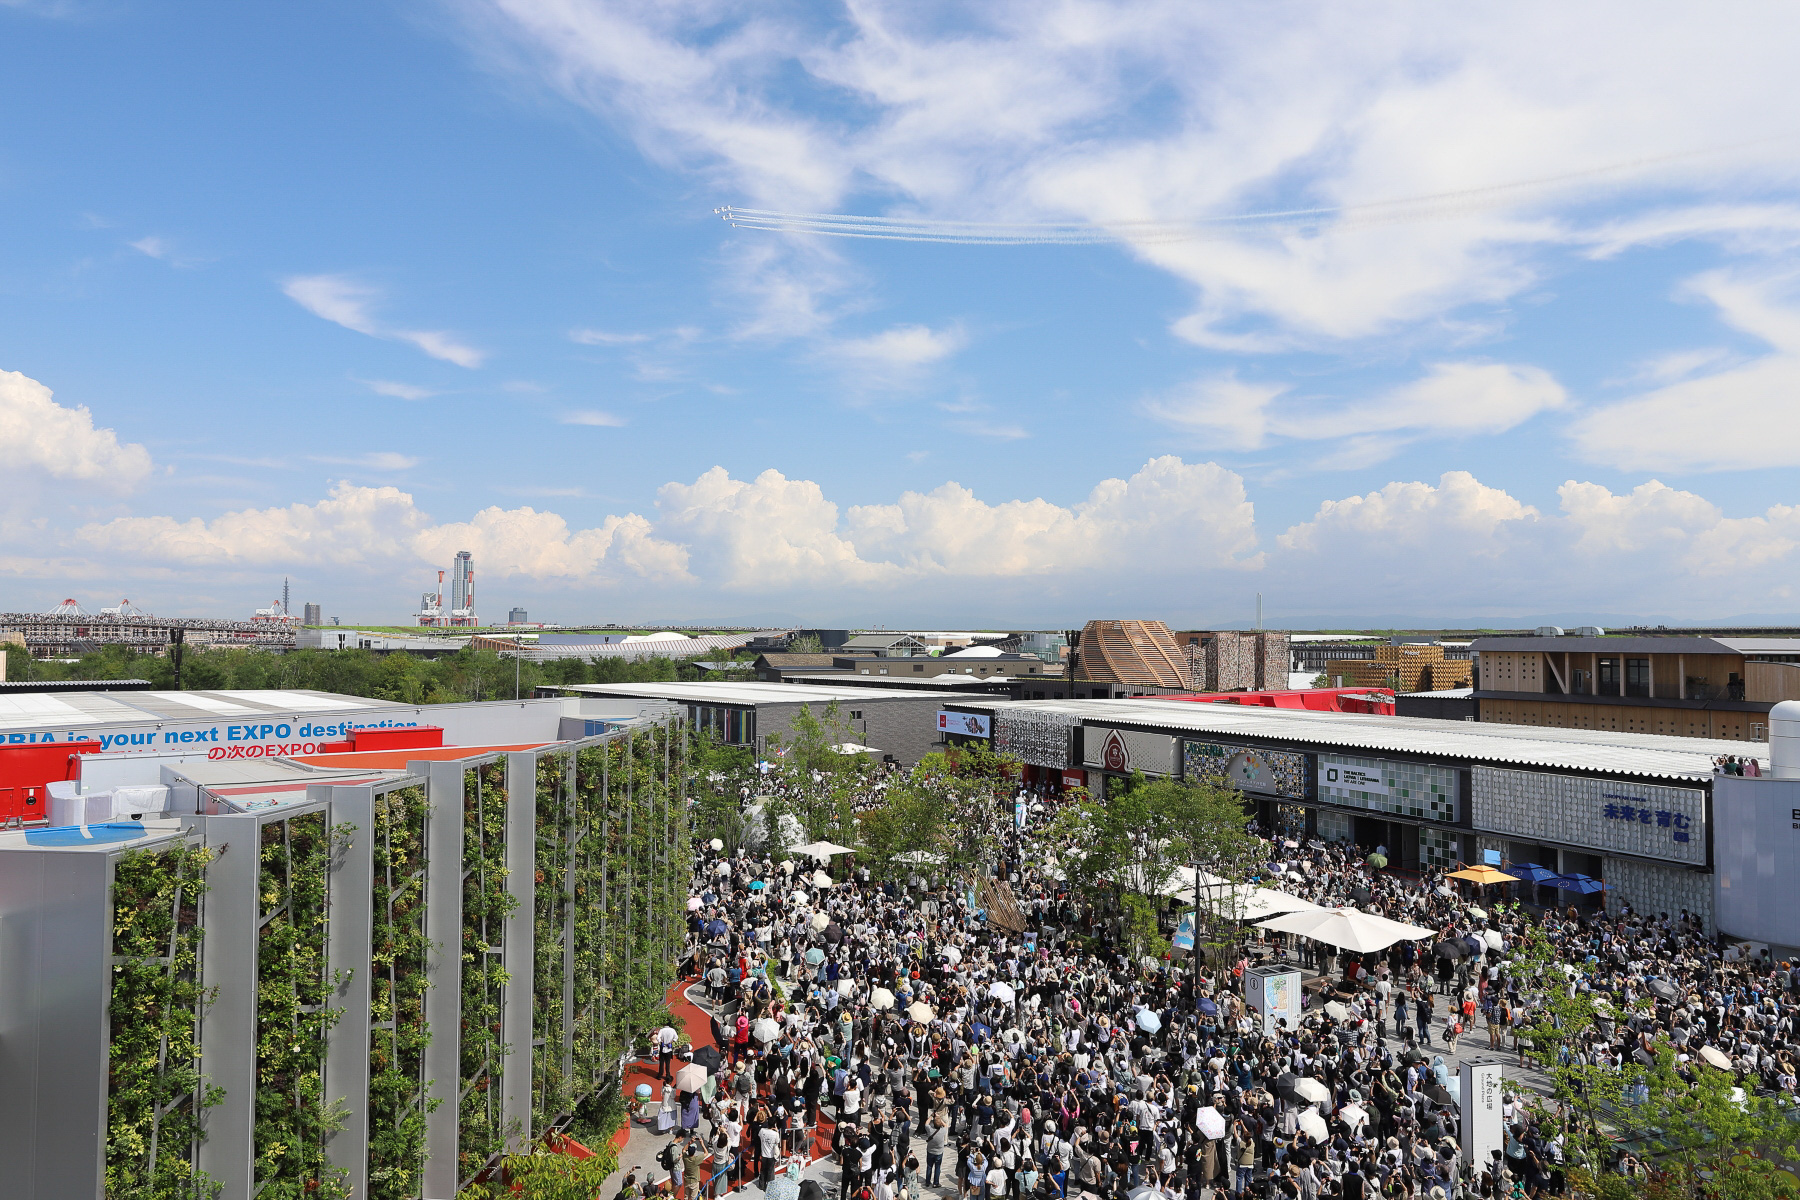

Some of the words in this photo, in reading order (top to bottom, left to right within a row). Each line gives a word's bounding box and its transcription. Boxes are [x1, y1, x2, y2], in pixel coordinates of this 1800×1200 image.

[100, 732, 157, 750] your
[165, 727, 219, 744] next
[228, 723, 292, 741] EXPO
[1603, 803, 1692, 830] 未来を育む
